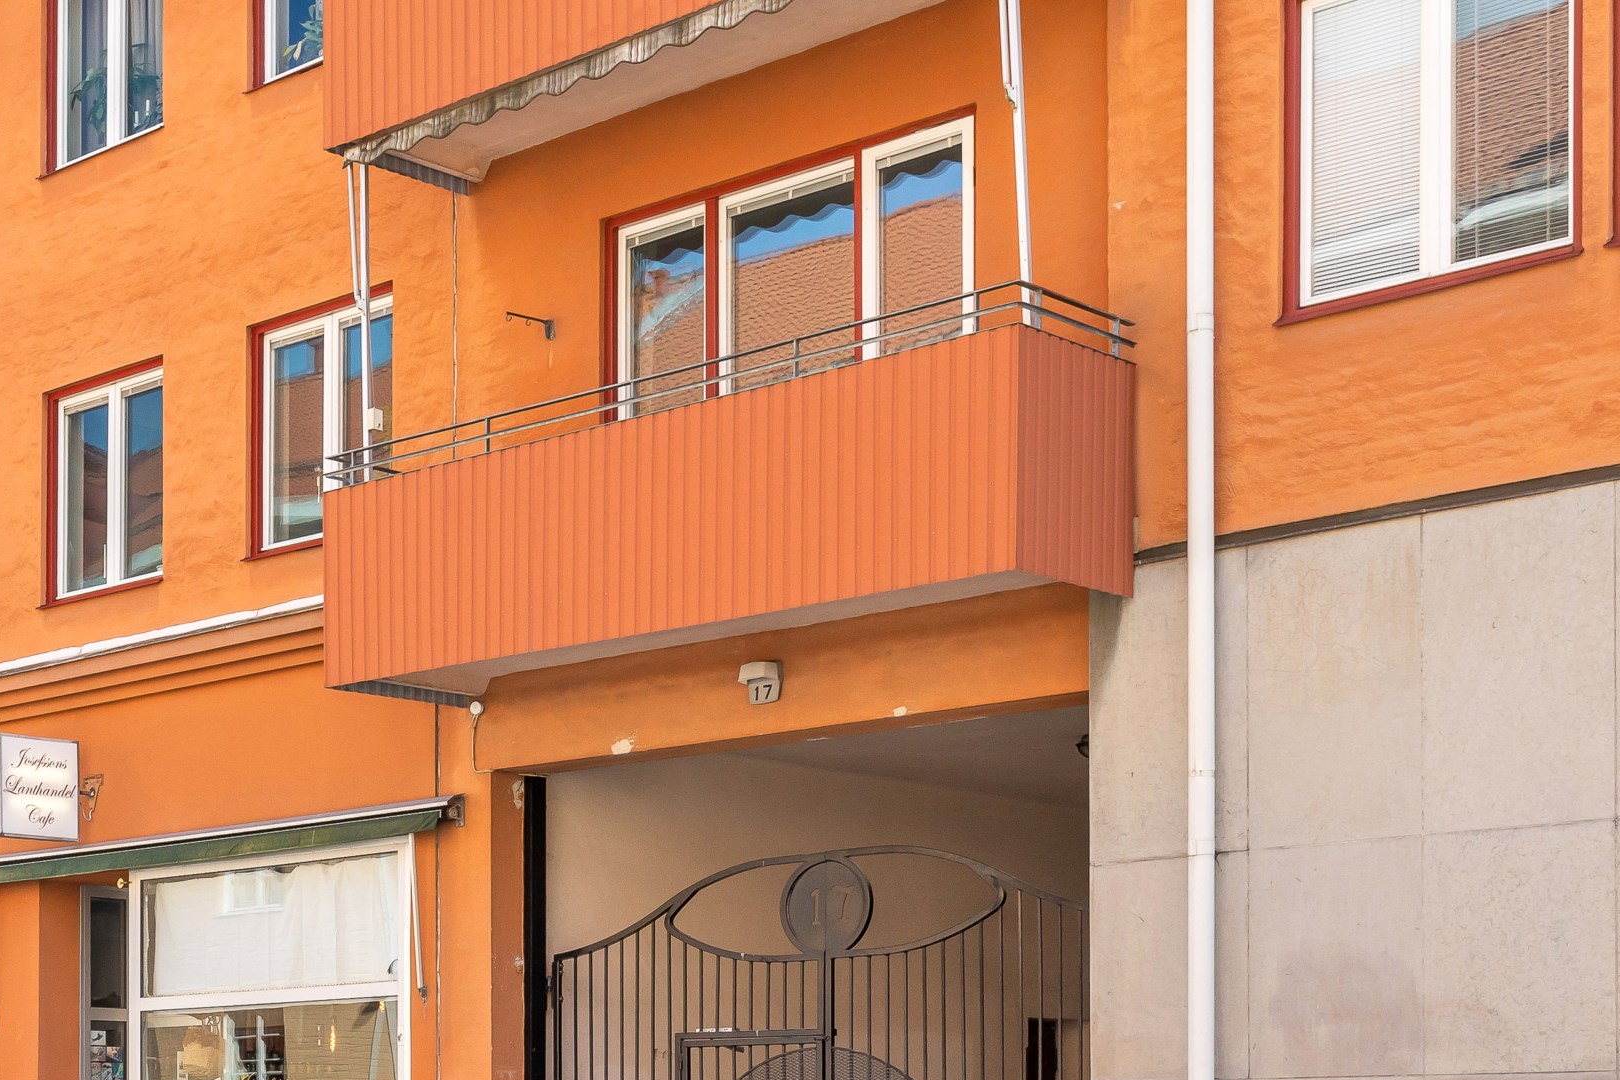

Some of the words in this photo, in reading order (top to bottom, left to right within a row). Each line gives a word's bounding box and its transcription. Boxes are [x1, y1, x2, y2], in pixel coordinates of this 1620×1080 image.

[755, 684, 773, 701] 17
[2, 774, 77, 799] Lanthandel
[810, 884, 854, 926] 17
